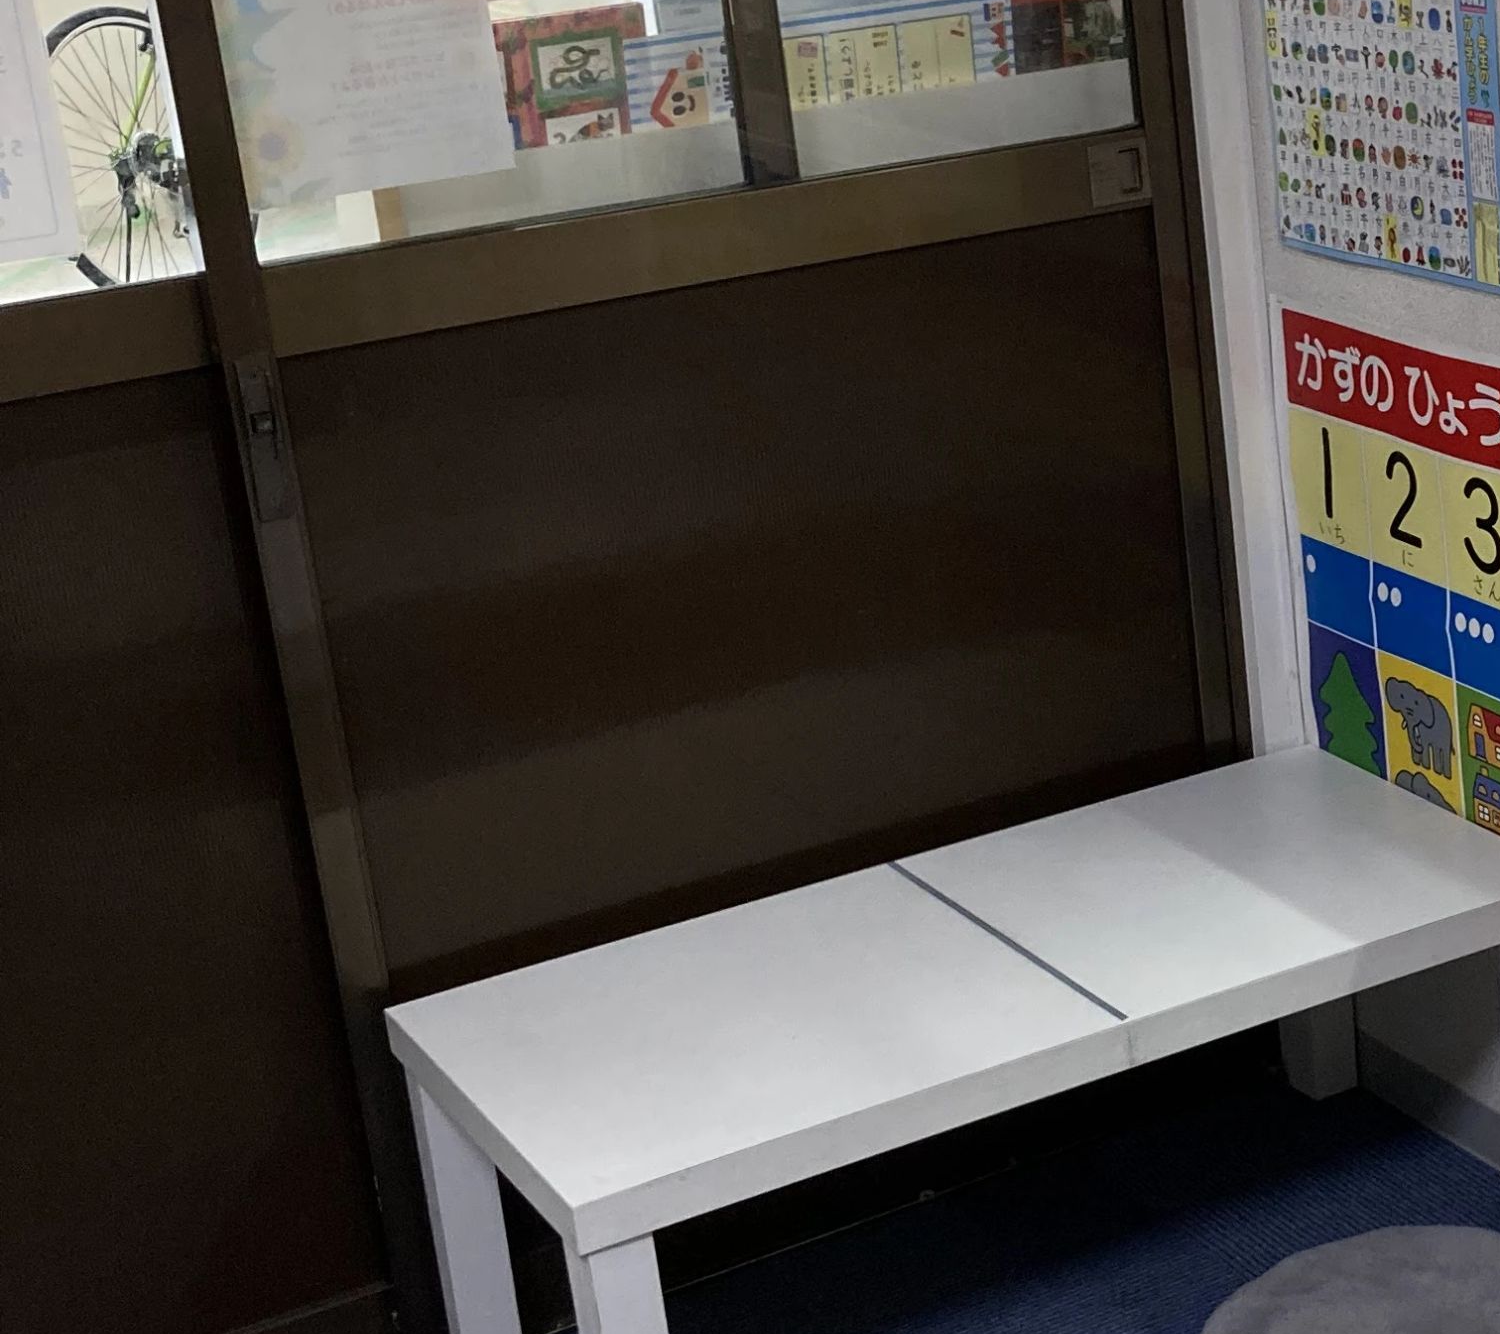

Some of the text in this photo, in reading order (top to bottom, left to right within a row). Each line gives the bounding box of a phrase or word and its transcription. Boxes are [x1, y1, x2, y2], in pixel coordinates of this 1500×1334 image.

[1295, 333, 1394, 412] かずの
[1321, 426, 1333, 519] 1
[1385, 451, 1423, 549] 2
[1319, 521, 1345, 545] いち
[1402, 550, 1415, 569] に
